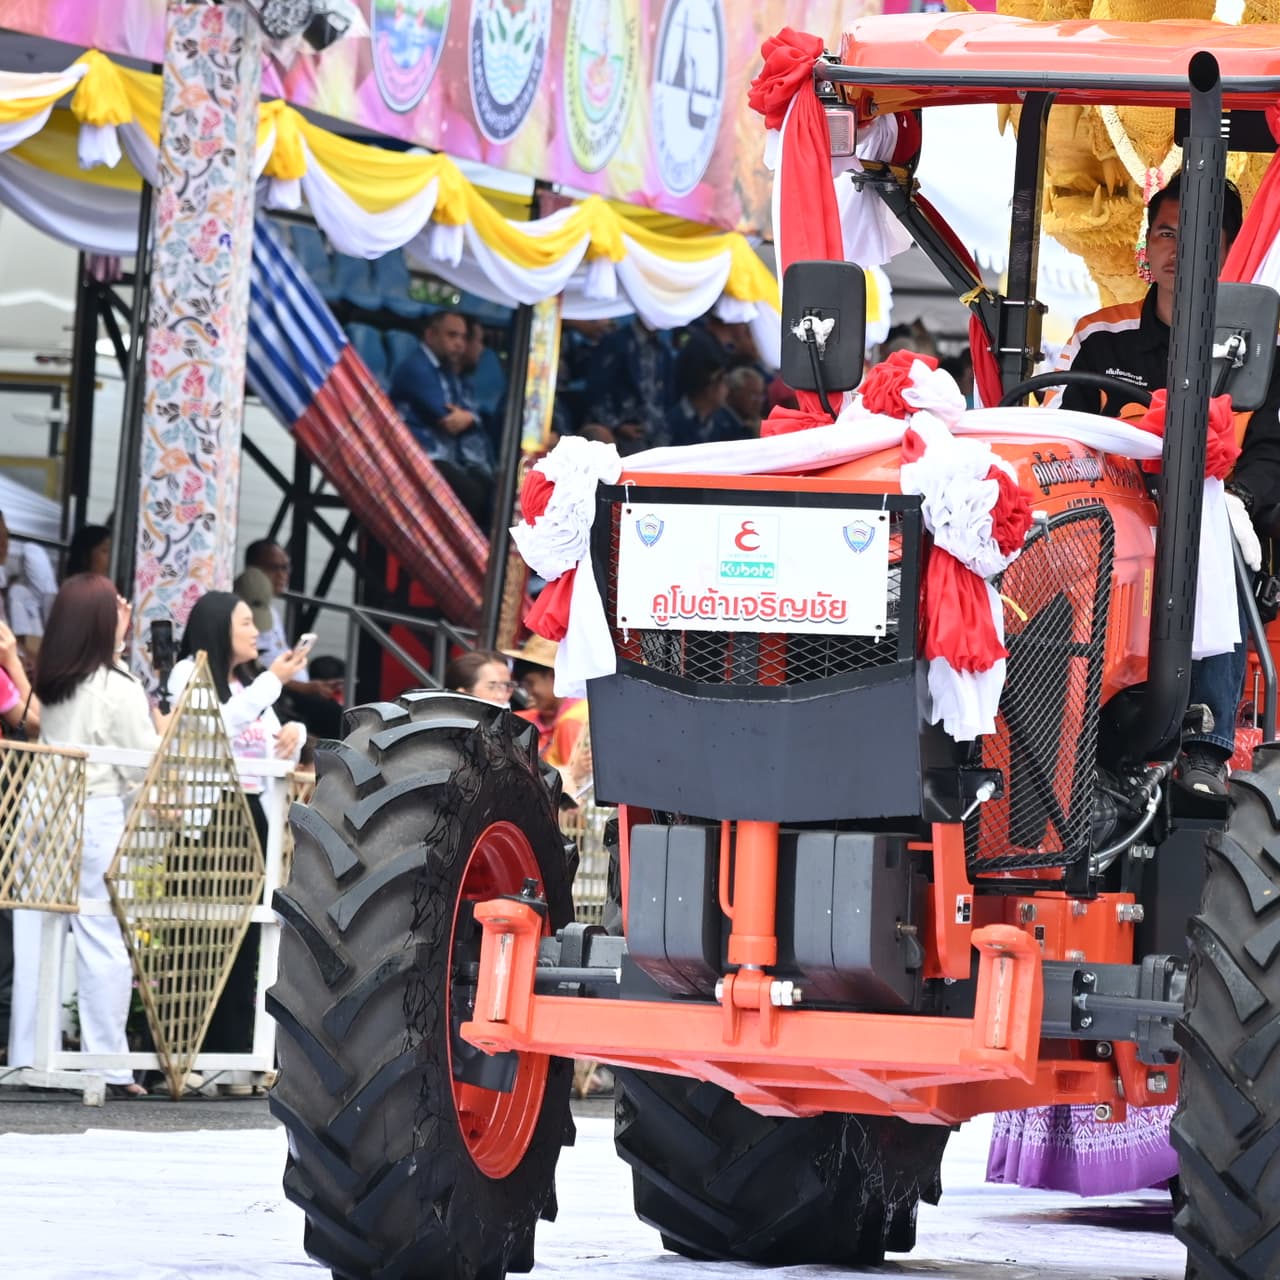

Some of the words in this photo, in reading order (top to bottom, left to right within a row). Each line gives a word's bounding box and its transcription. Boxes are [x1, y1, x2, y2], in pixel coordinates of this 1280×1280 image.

[721, 562, 775, 578] Kubota
[651, 586, 848, 622] คูโบต้าเจริญชัย
